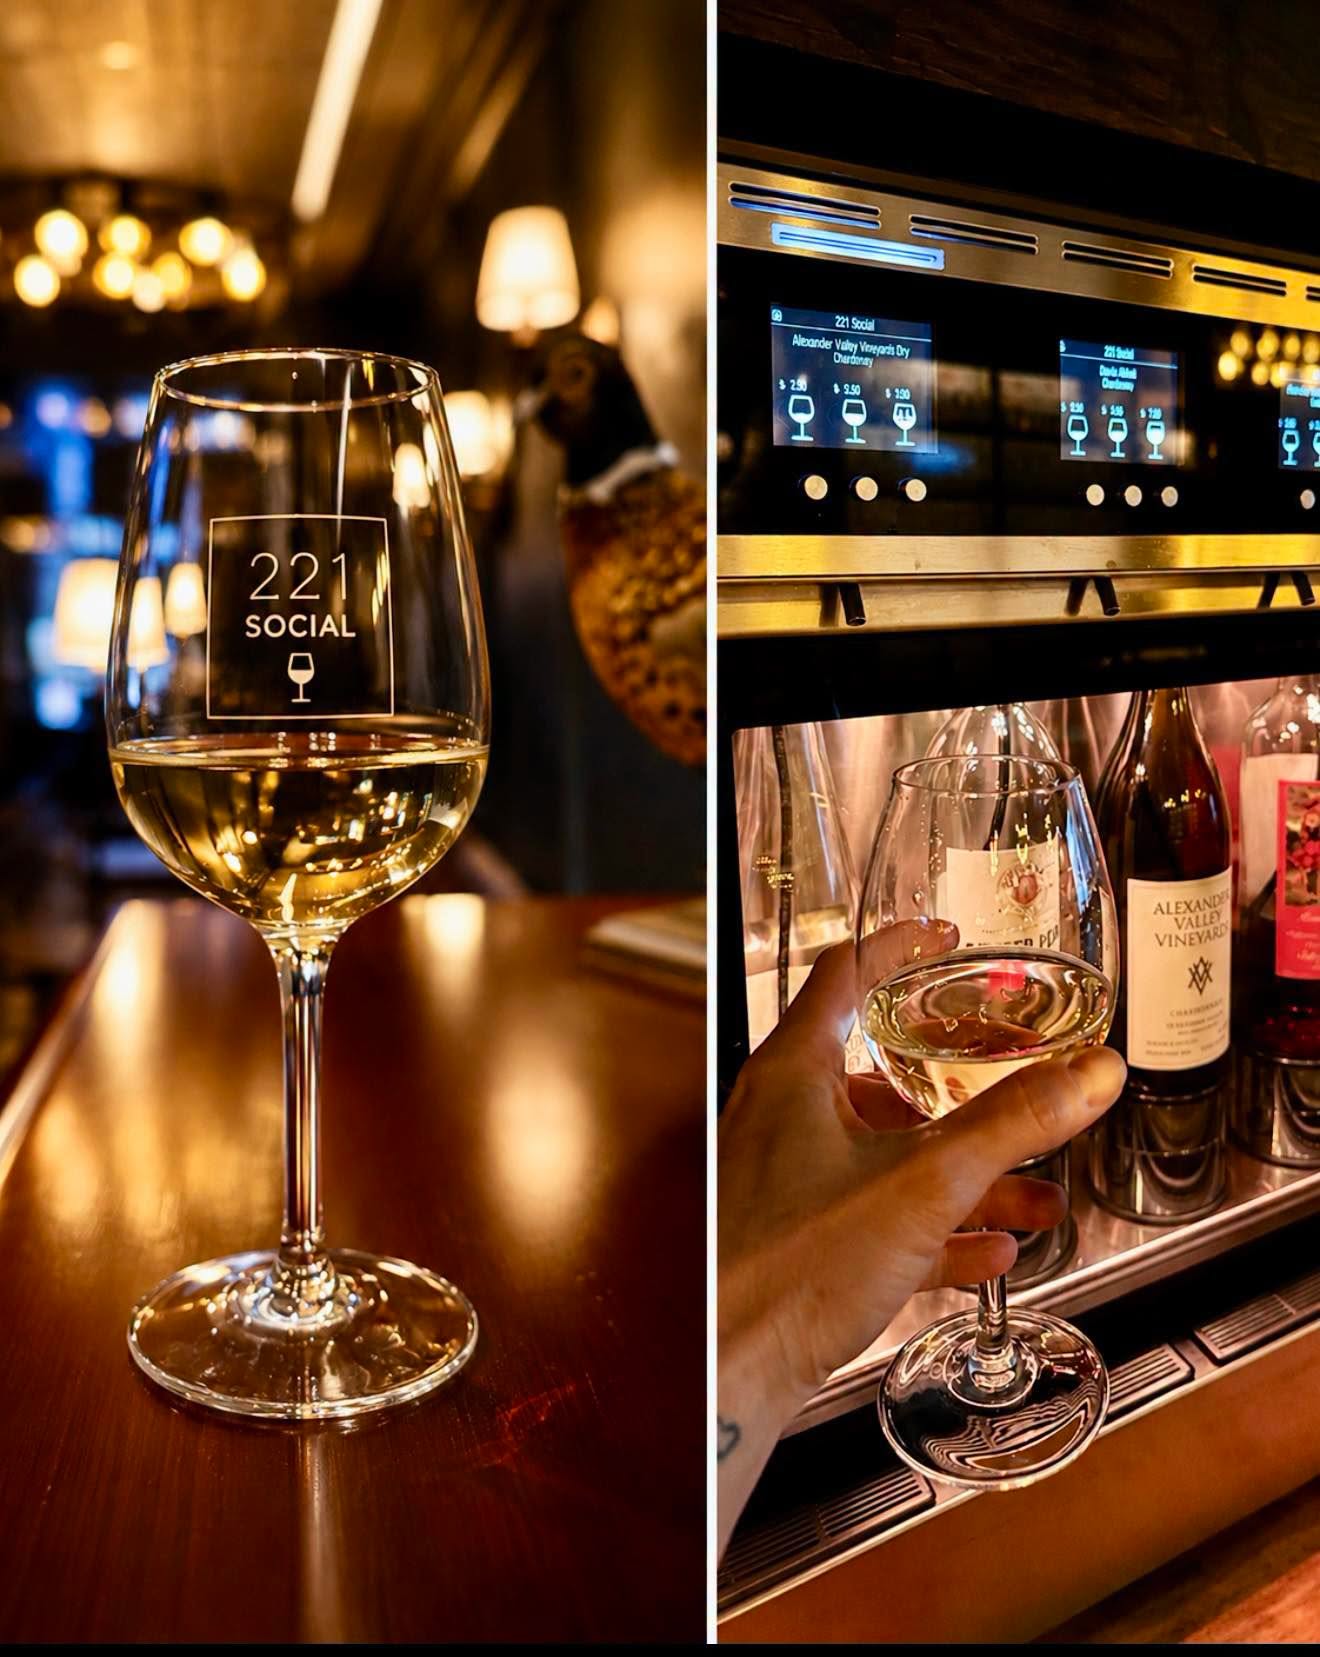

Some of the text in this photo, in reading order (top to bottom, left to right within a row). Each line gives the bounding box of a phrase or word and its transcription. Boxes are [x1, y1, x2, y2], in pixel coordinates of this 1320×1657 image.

[835, 315, 875, 331] 221 Social
[792, 334, 833, 349] Alexander
[249, 552, 347, 601] 221
[245, 613, 357, 639] SOCIAL
[1174, 908, 1222, 930] VALLEY
